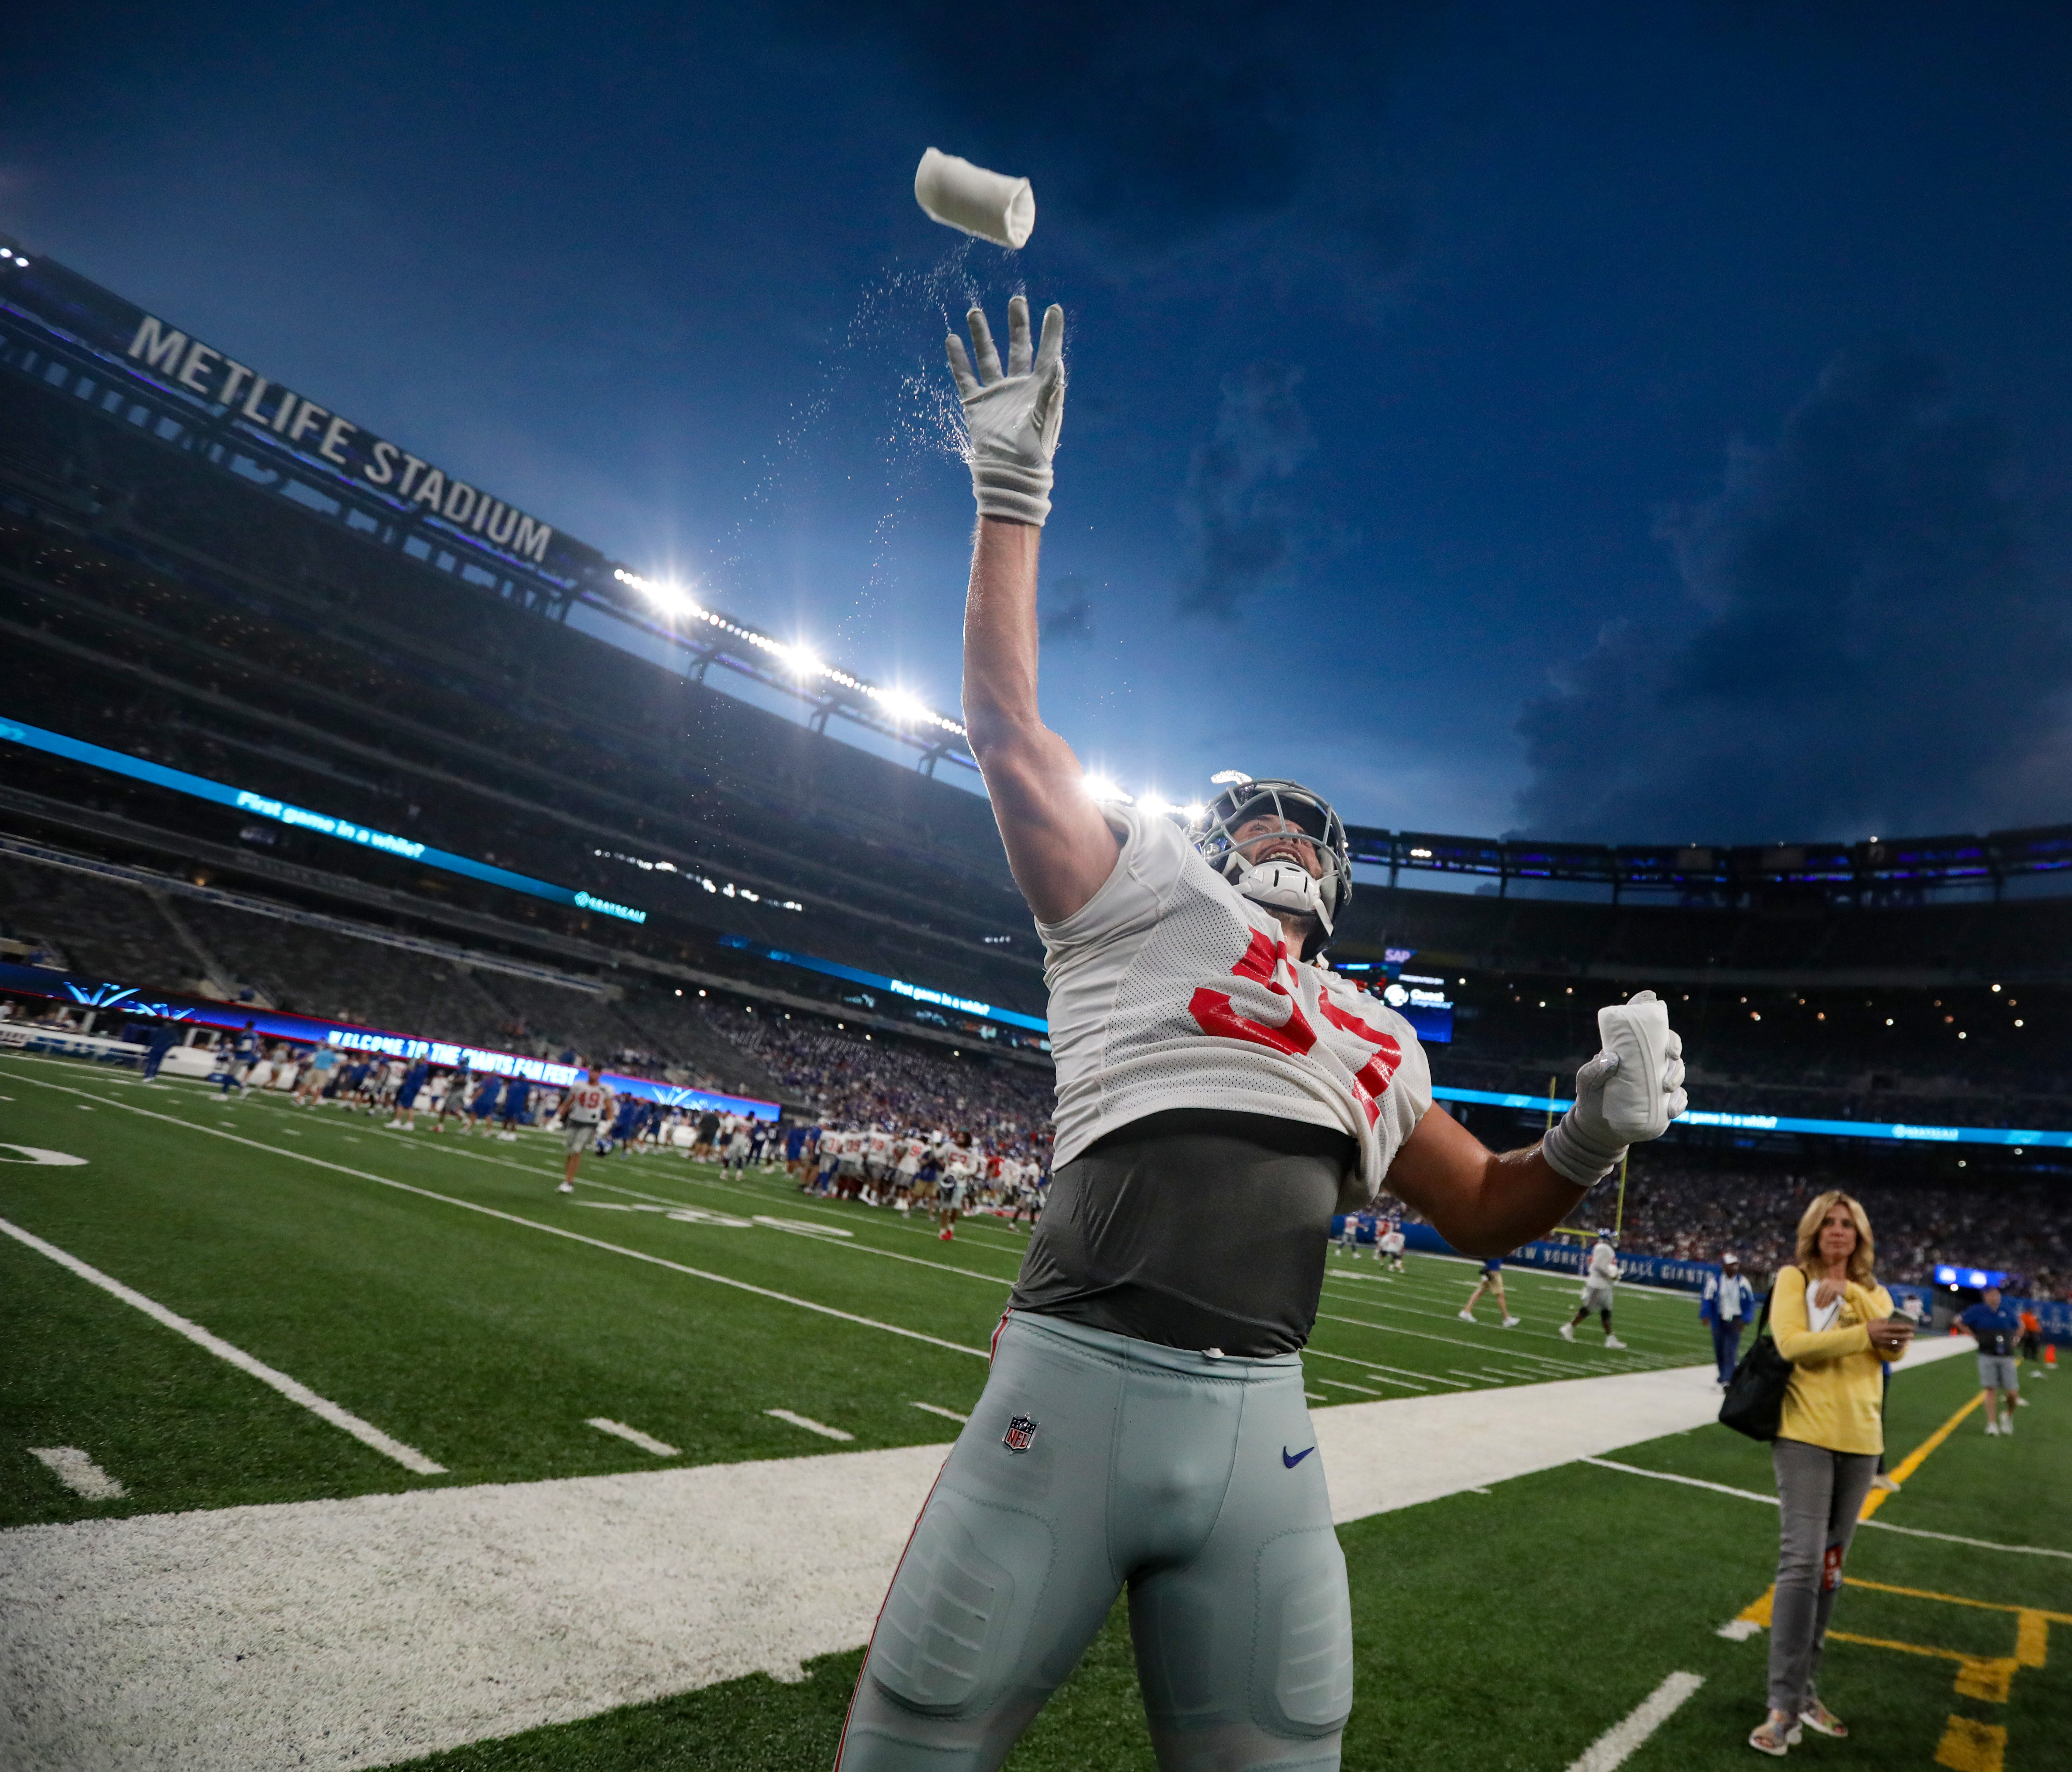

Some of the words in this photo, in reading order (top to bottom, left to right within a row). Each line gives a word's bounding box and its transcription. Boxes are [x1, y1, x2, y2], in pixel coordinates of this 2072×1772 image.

[127, 316, 357, 464] METLIFE
[363, 441, 552, 562] STADIUM
[237, 791, 283, 816] First
[282, 807, 336, 833] game
[336, 820, 356, 839] in
[371, 832, 425, 858] while?
[1385, 949, 1411, 963] SAP
[891, 979, 914, 996] First
[1410, 988, 1445, 1001] Quest
[328, 1030, 405, 1056] WELCOME
[430, 1043, 462, 1066] THE
[541, 1063, 579, 1086] FEST
[577, 1091, 600, 1109] 49
[1689, 1112, 1720, 1125] game
[1720, 1112, 1732, 1125] in
[1742, 1115, 1778, 1128] while?
[1515, 1246, 1537, 1260] EW
[1543, 1249, 1578, 1265] YORK
[1007, 1429, 1027, 1448] NFL
